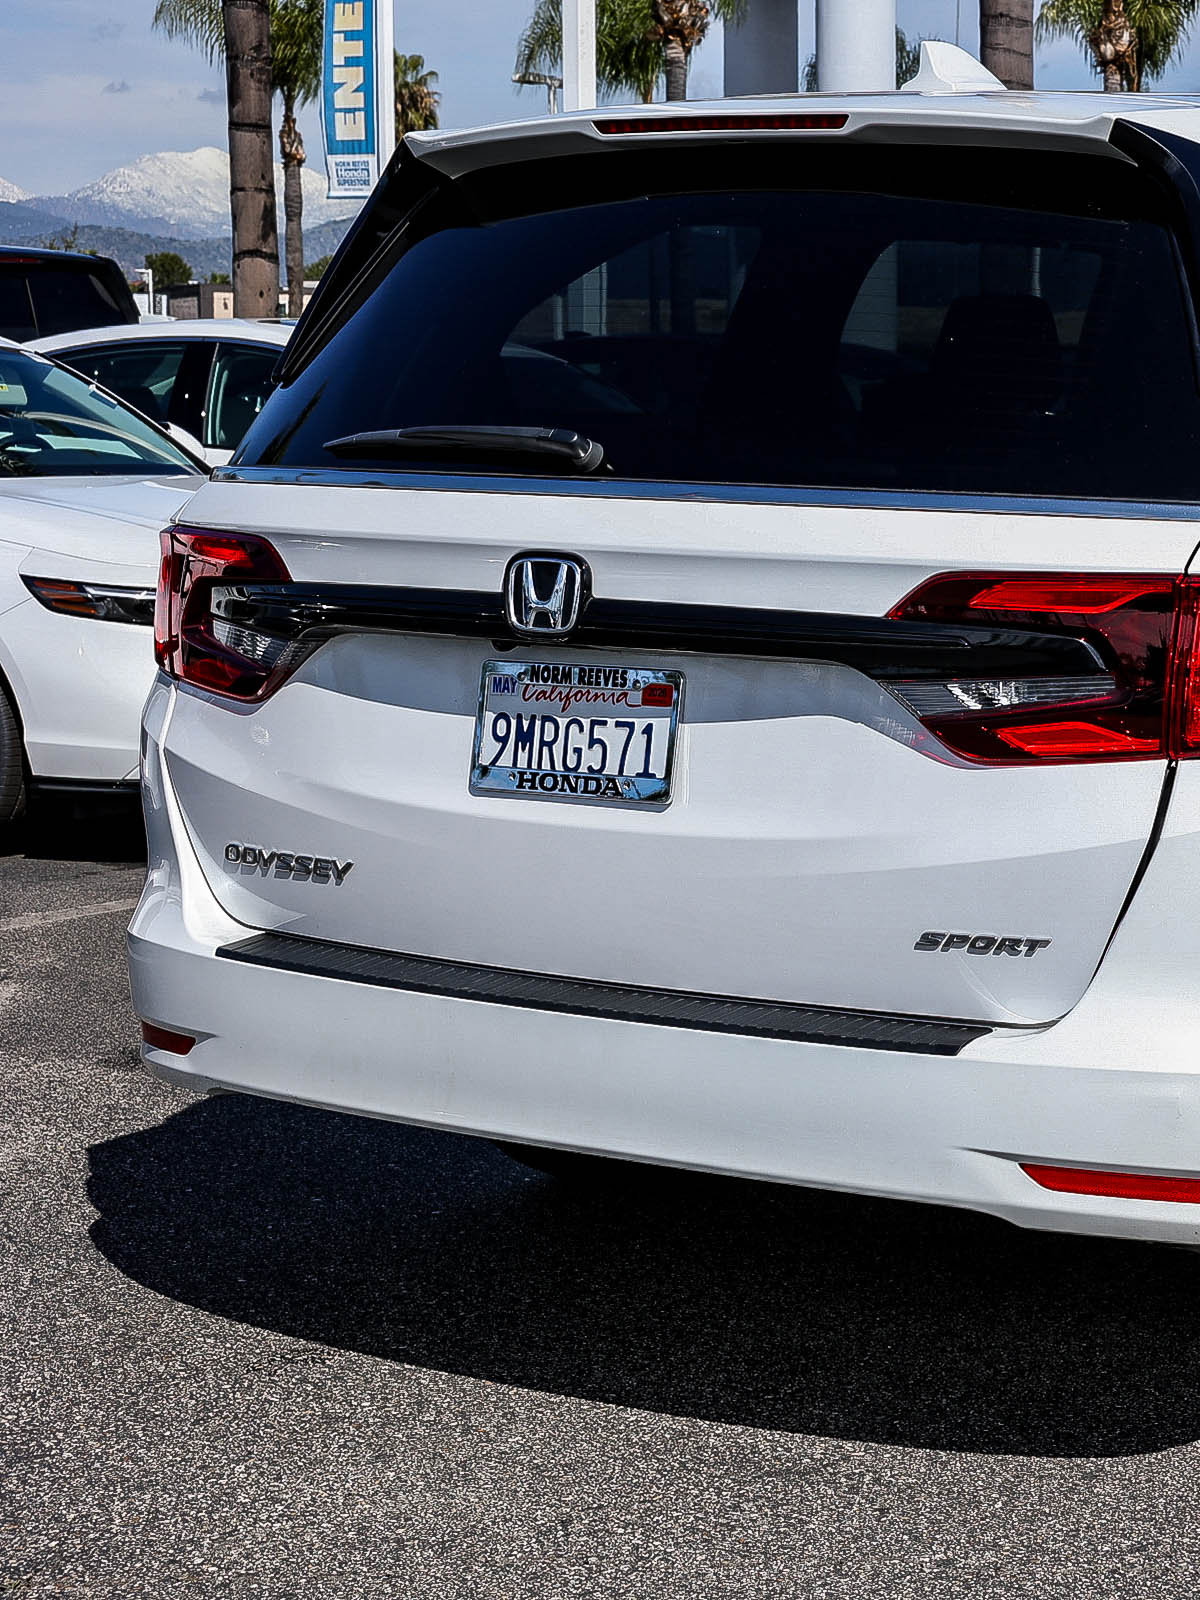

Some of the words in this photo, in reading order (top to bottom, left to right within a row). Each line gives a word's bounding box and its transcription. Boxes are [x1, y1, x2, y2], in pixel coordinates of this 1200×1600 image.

[338, 168, 369, 178] Honda
[492, 676, 518, 694] MAY
[529, 664, 575, 686] NORM
[577, 666, 628, 688] REEVES
[521, 683, 642, 713] California
[488, 711, 657, 778] 9MRG571
[515, 770, 624, 797] HONDA
[224, 843, 355, 884] ODYSSEY
[913, 931, 1052, 958] SPORT
